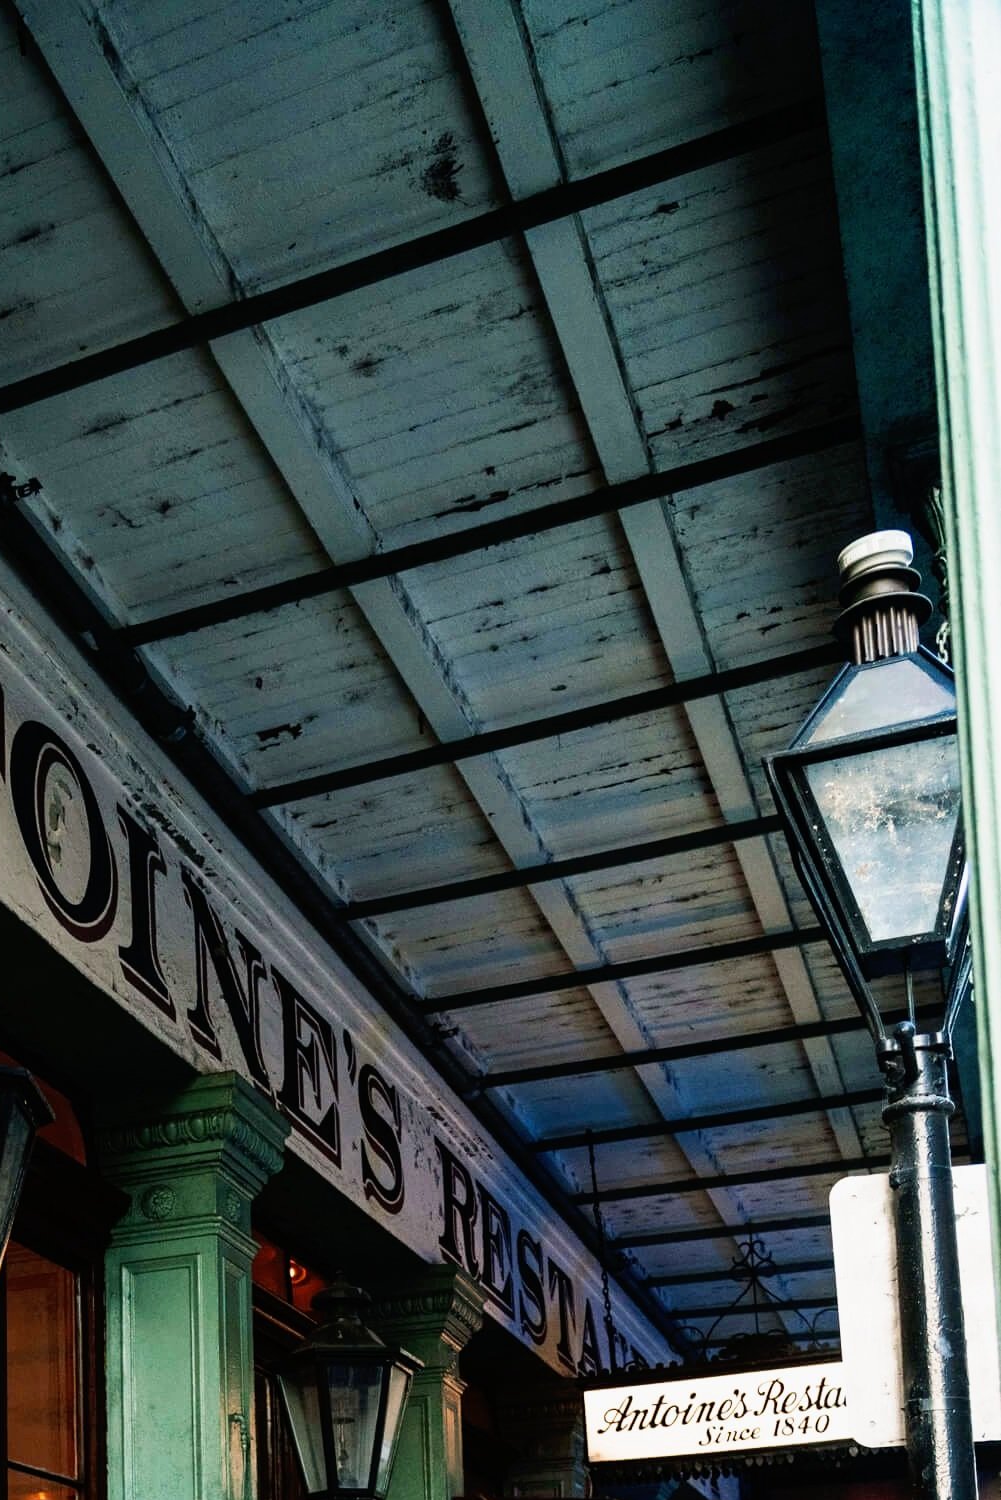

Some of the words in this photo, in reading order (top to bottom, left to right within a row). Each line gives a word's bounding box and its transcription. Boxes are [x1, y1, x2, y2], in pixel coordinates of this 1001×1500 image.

[597, 1388, 750, 1434] Antoine's
[753, 1377, 847, 1417] Resta
[698, 1425, 762, 1446] Since
[773, 1414, 830, 1437] 1840
